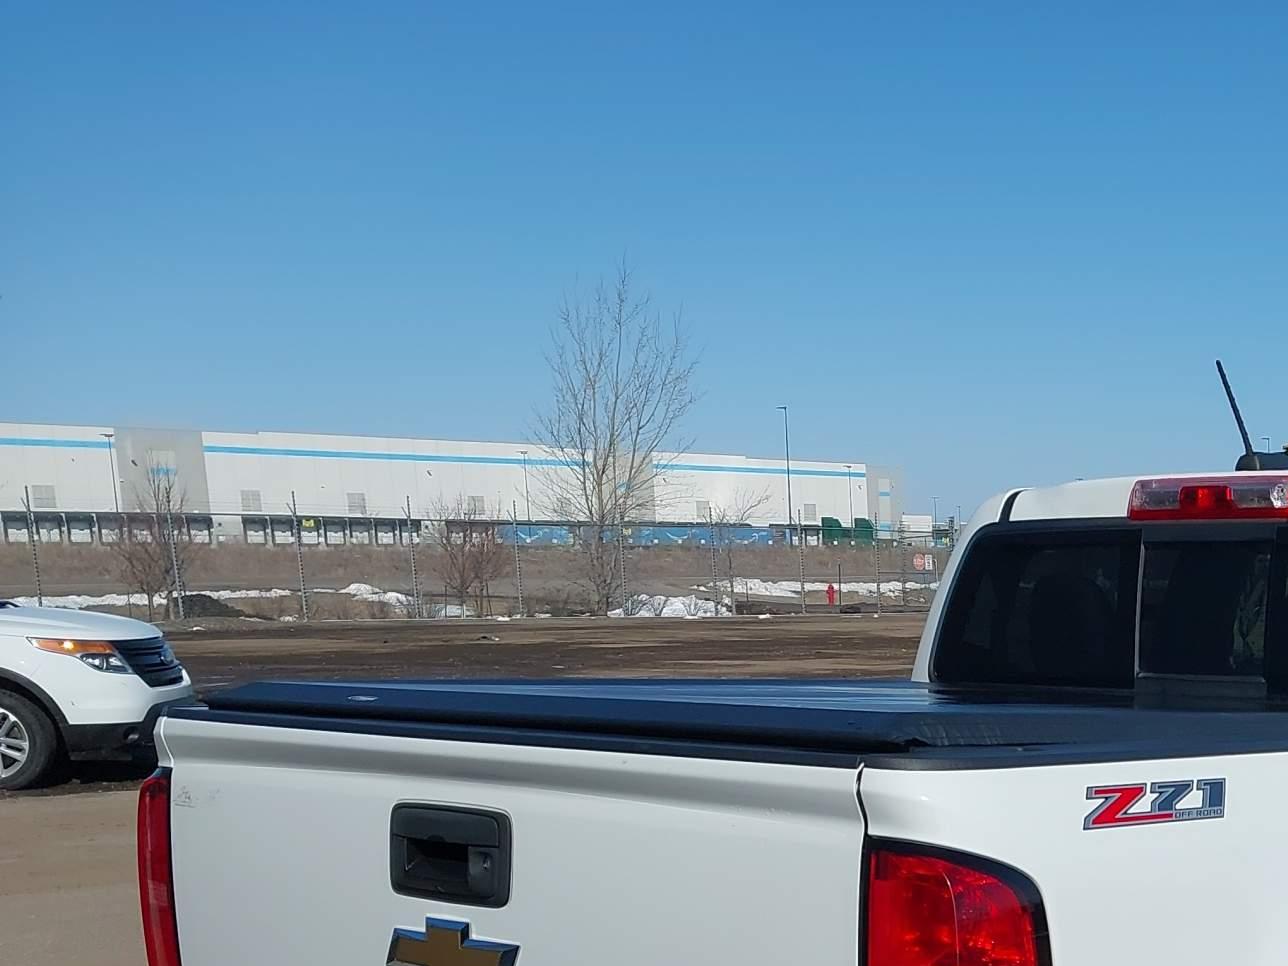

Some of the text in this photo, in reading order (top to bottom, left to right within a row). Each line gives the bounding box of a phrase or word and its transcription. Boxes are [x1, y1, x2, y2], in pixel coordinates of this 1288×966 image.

[1083, 778, 1226, 830] Z71
[1174, 808, 1223, 819] OFF ROAD
